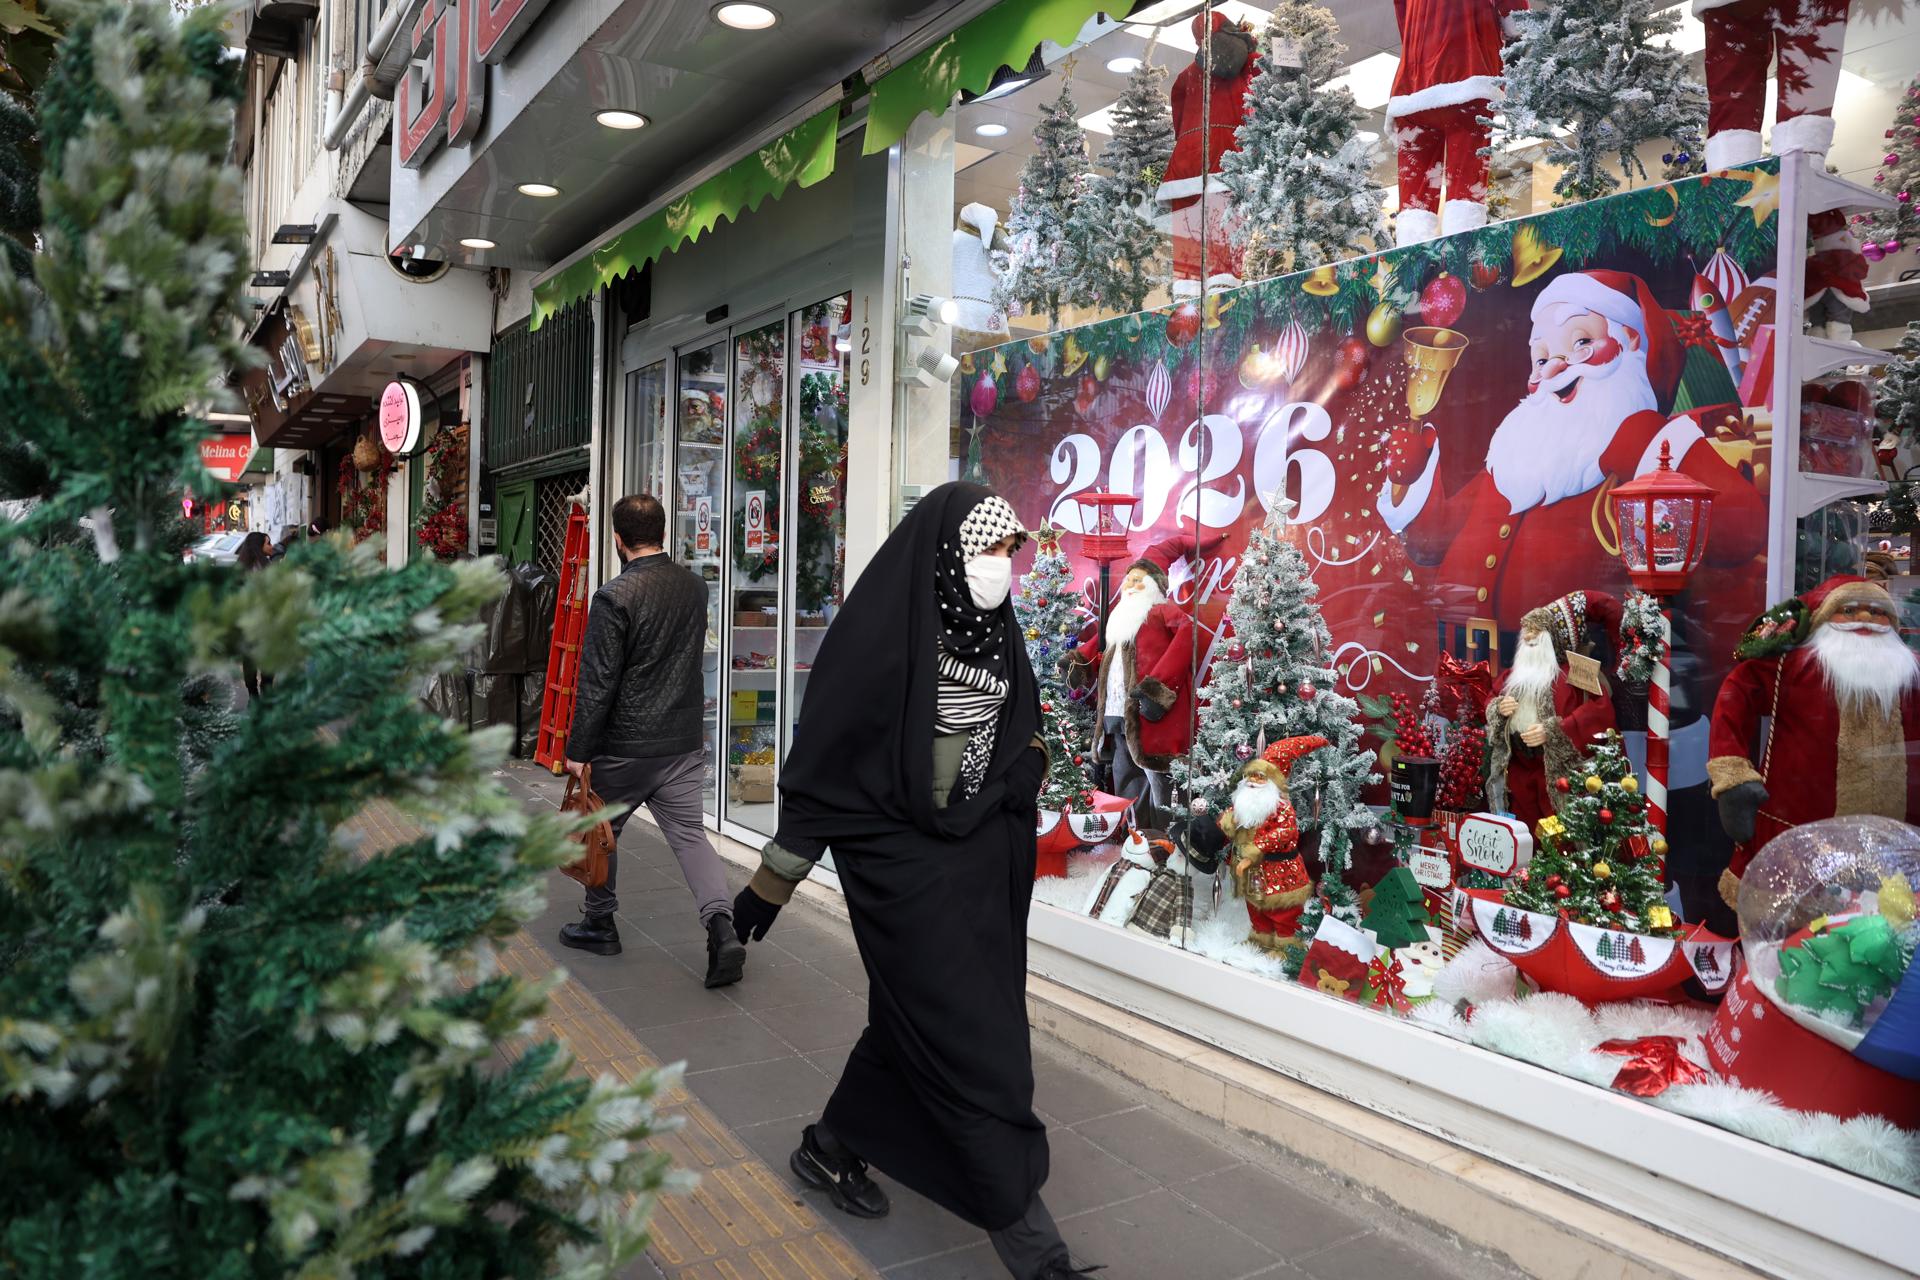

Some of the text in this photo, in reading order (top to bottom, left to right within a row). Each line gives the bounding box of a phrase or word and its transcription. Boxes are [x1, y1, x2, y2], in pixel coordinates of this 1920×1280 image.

[861, 295, 870, 386] 129
[200, 445, 236, 459] Melina
[1048, 401, 1337, 534] 2026
[1420, 861, 1440, 871] MERRY
[1414, 867, 1444, 880] CHRISTMAS
